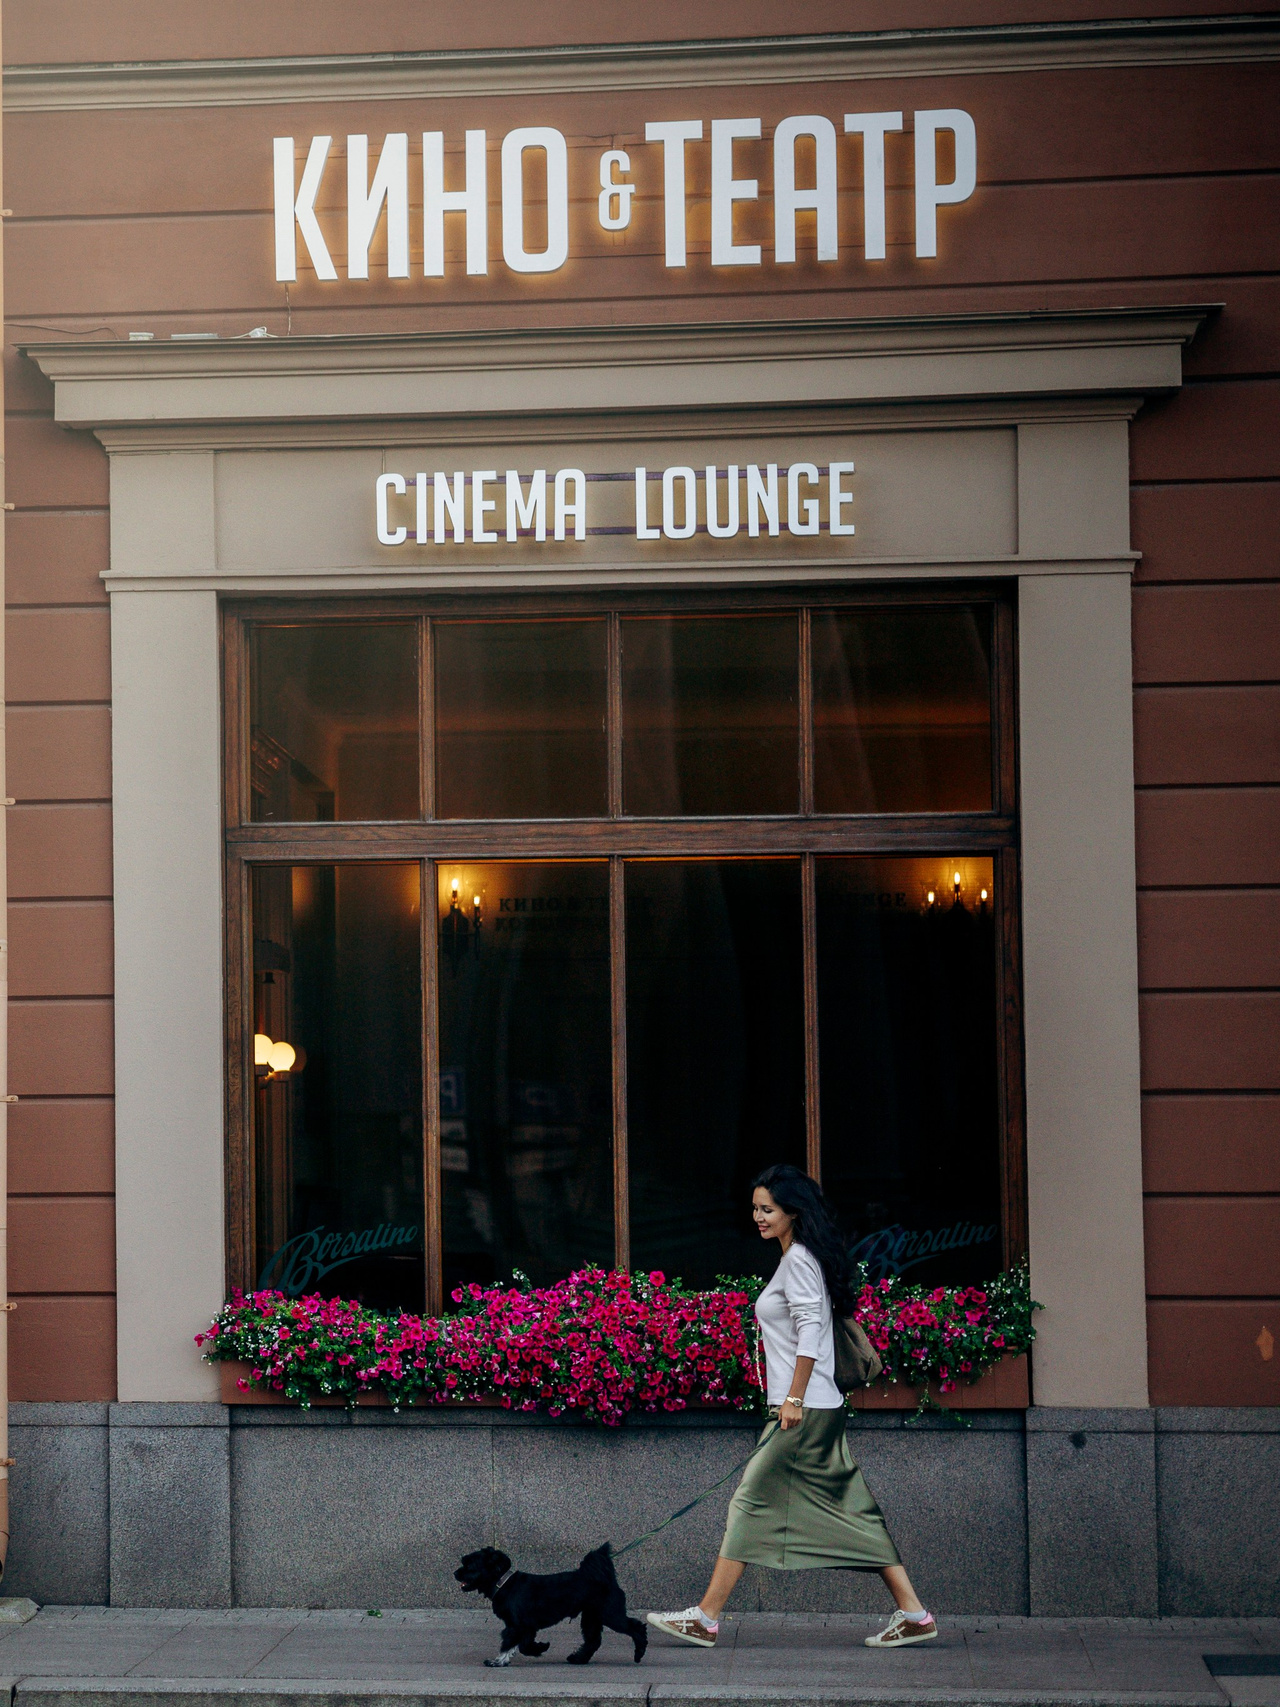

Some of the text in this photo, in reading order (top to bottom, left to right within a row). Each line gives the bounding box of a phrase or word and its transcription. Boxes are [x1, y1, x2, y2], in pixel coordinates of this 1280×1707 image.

[273, 108, 977, 283] КИНО & ТЕАТР
[376, 461, 856, 545] CINEMA LOUNGE
[258, 1222, 418, 1296] Borsalino
[846, 1221, 998, 1287] Borsalino
